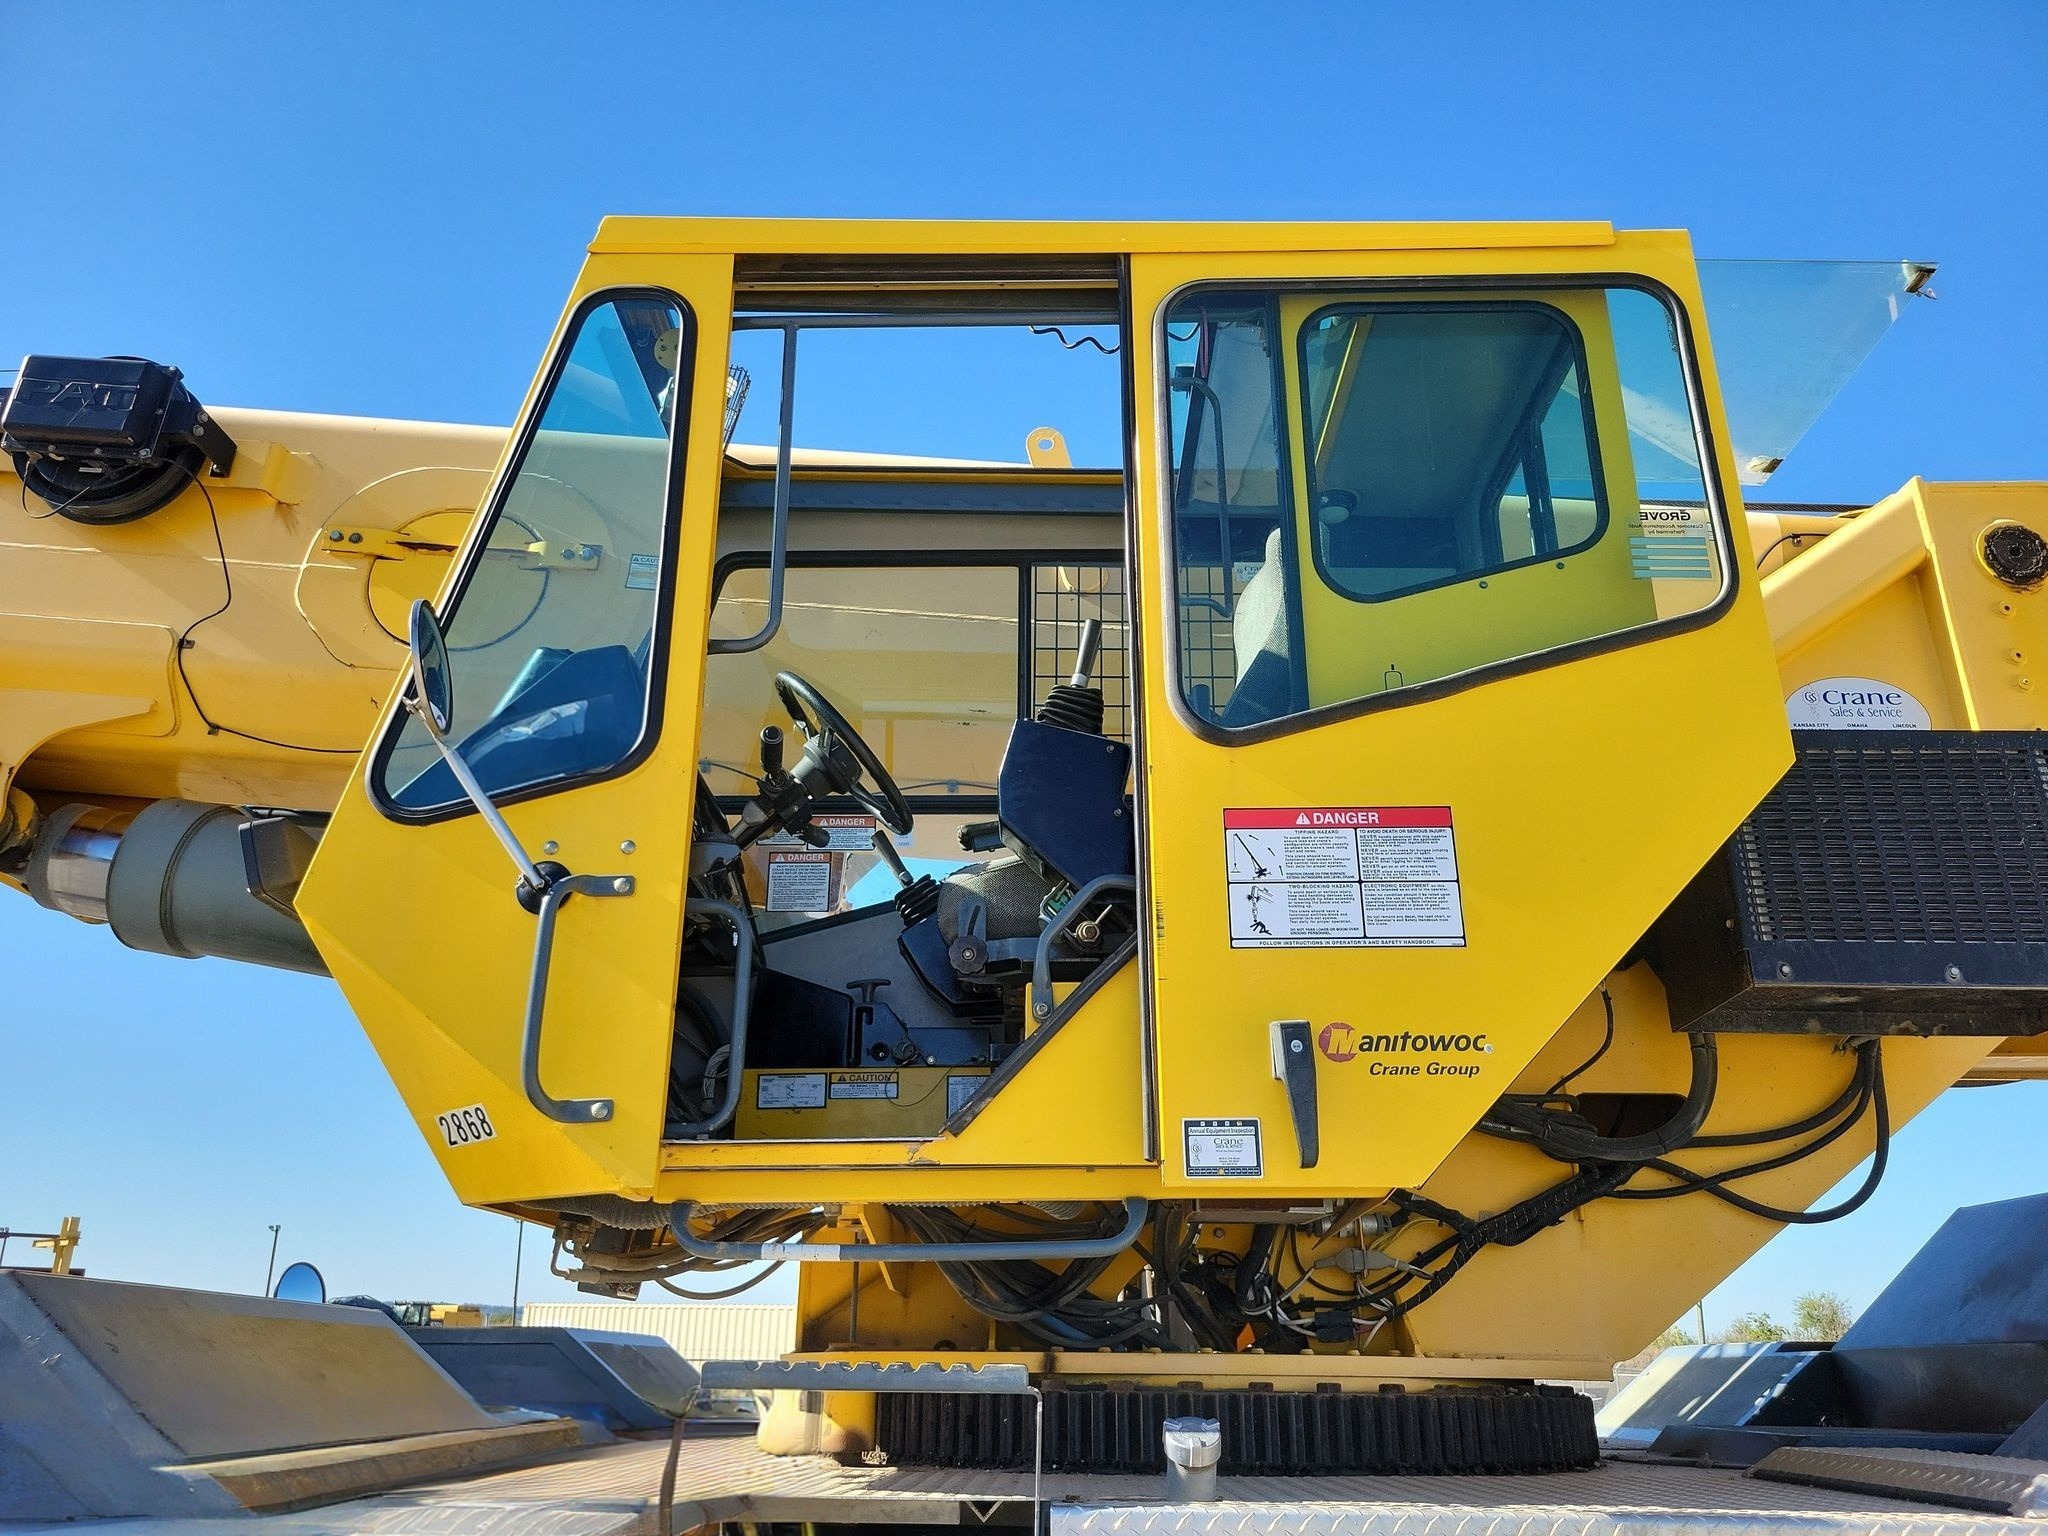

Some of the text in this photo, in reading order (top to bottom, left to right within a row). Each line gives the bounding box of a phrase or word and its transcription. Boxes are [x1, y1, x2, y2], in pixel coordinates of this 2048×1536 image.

[16, 378, 139, 410] PAT
[1822, 690, 1902, 705] Crane
[1830, 706, 1902, 717] Sales & Service
[829, 818, 865, 826] DANGER
[1313, 812, 1379, 824] DANGER
[1322, 1026, 1486, 1057] Manitowoc
[1369, 1062, 1480, 1078] Crane Group
[439, 1107, 493, 1146] 2868
